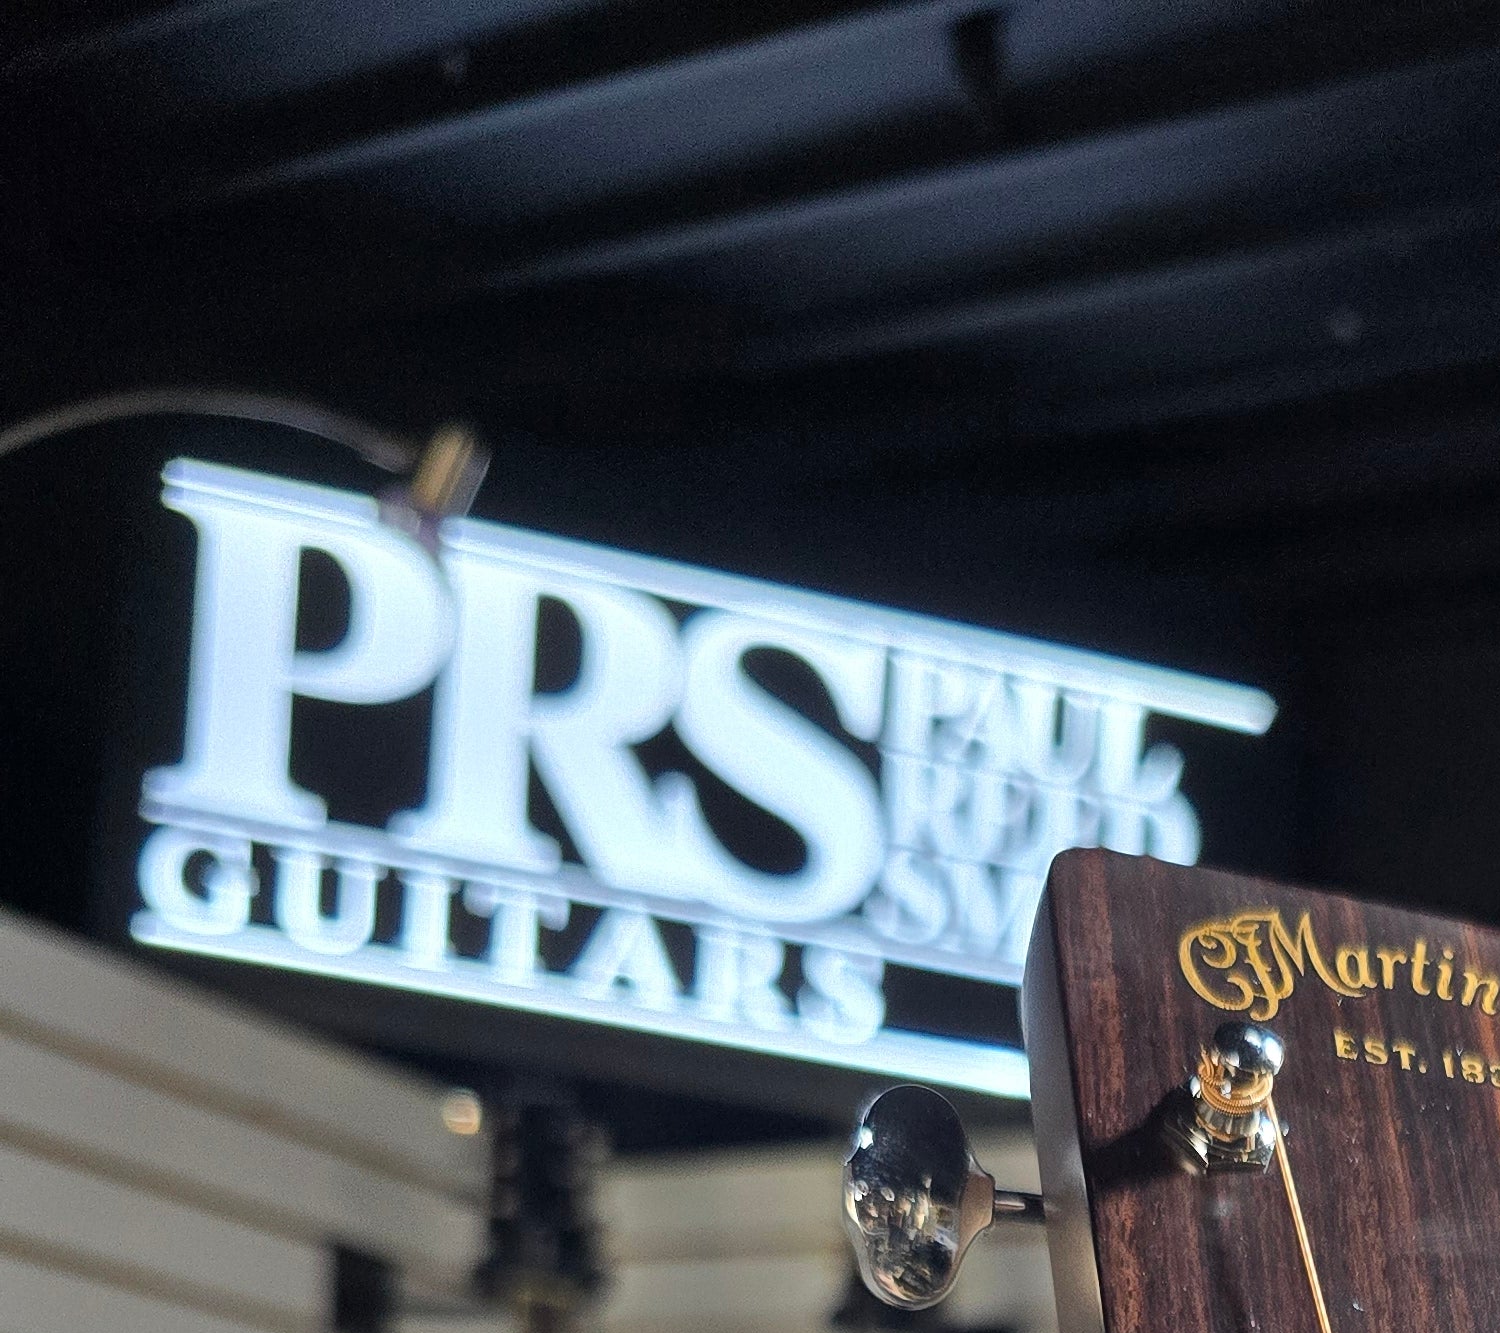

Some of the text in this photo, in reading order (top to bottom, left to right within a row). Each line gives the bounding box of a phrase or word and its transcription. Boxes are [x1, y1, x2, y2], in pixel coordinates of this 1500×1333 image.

[142, 484, 888, 923] PRS
[882, 652, 1184, 803] PAUL
[137, 826, 887, 1045] GUITARS
[1335, 1027, 1427, 1074] EST.
